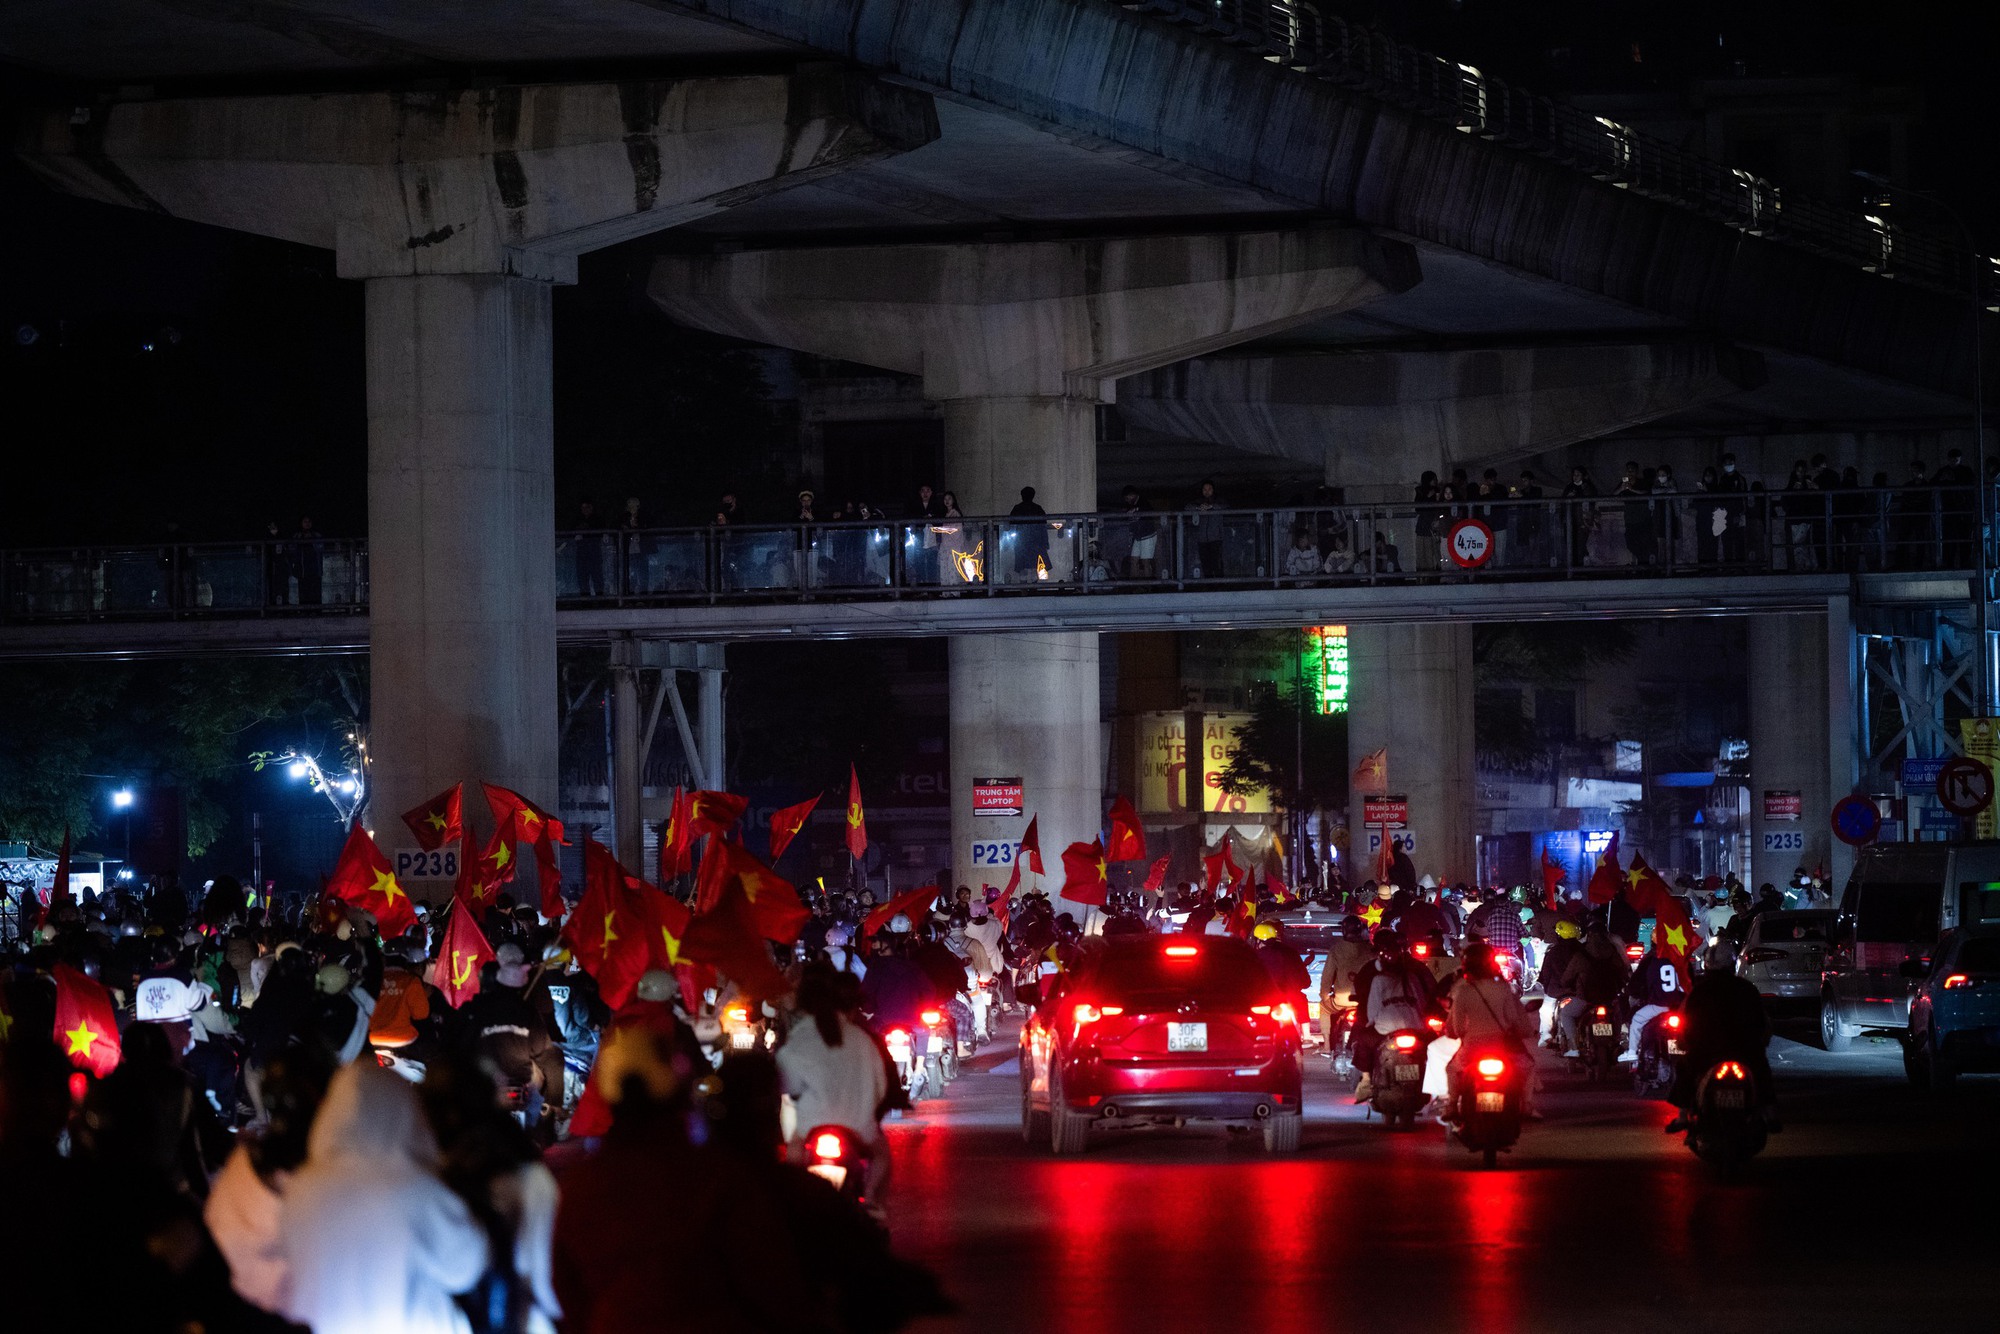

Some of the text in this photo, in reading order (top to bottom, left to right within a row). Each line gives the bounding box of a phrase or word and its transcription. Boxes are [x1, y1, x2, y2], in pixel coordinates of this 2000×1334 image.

[1206, 722, 1224, 740] ÃI
[1004, 787, 1021, 796] TÂM
[1370, 834, 1414, 852] P6
[1765, 833, 1802, 849] P235
[398, 852, 457, 876] P238
[1660, 964, 1676, 992] 9
